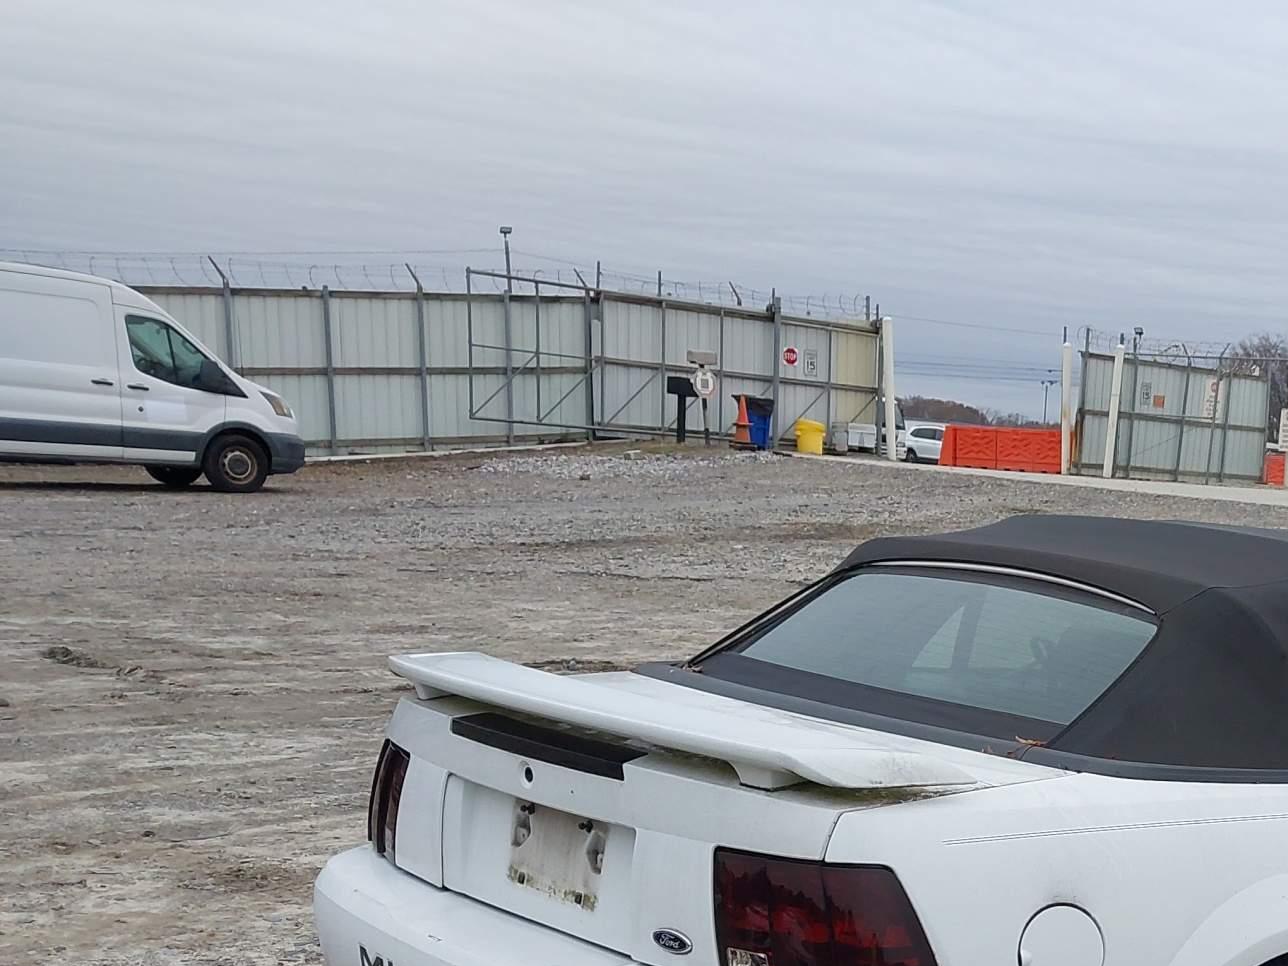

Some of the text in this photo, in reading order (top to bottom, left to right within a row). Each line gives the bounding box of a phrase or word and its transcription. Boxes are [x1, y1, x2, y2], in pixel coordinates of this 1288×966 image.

[784, 352, 797, 360] STOP
[807, 361, 816, 370] 15
[659, 933, 682, 949] Ford
